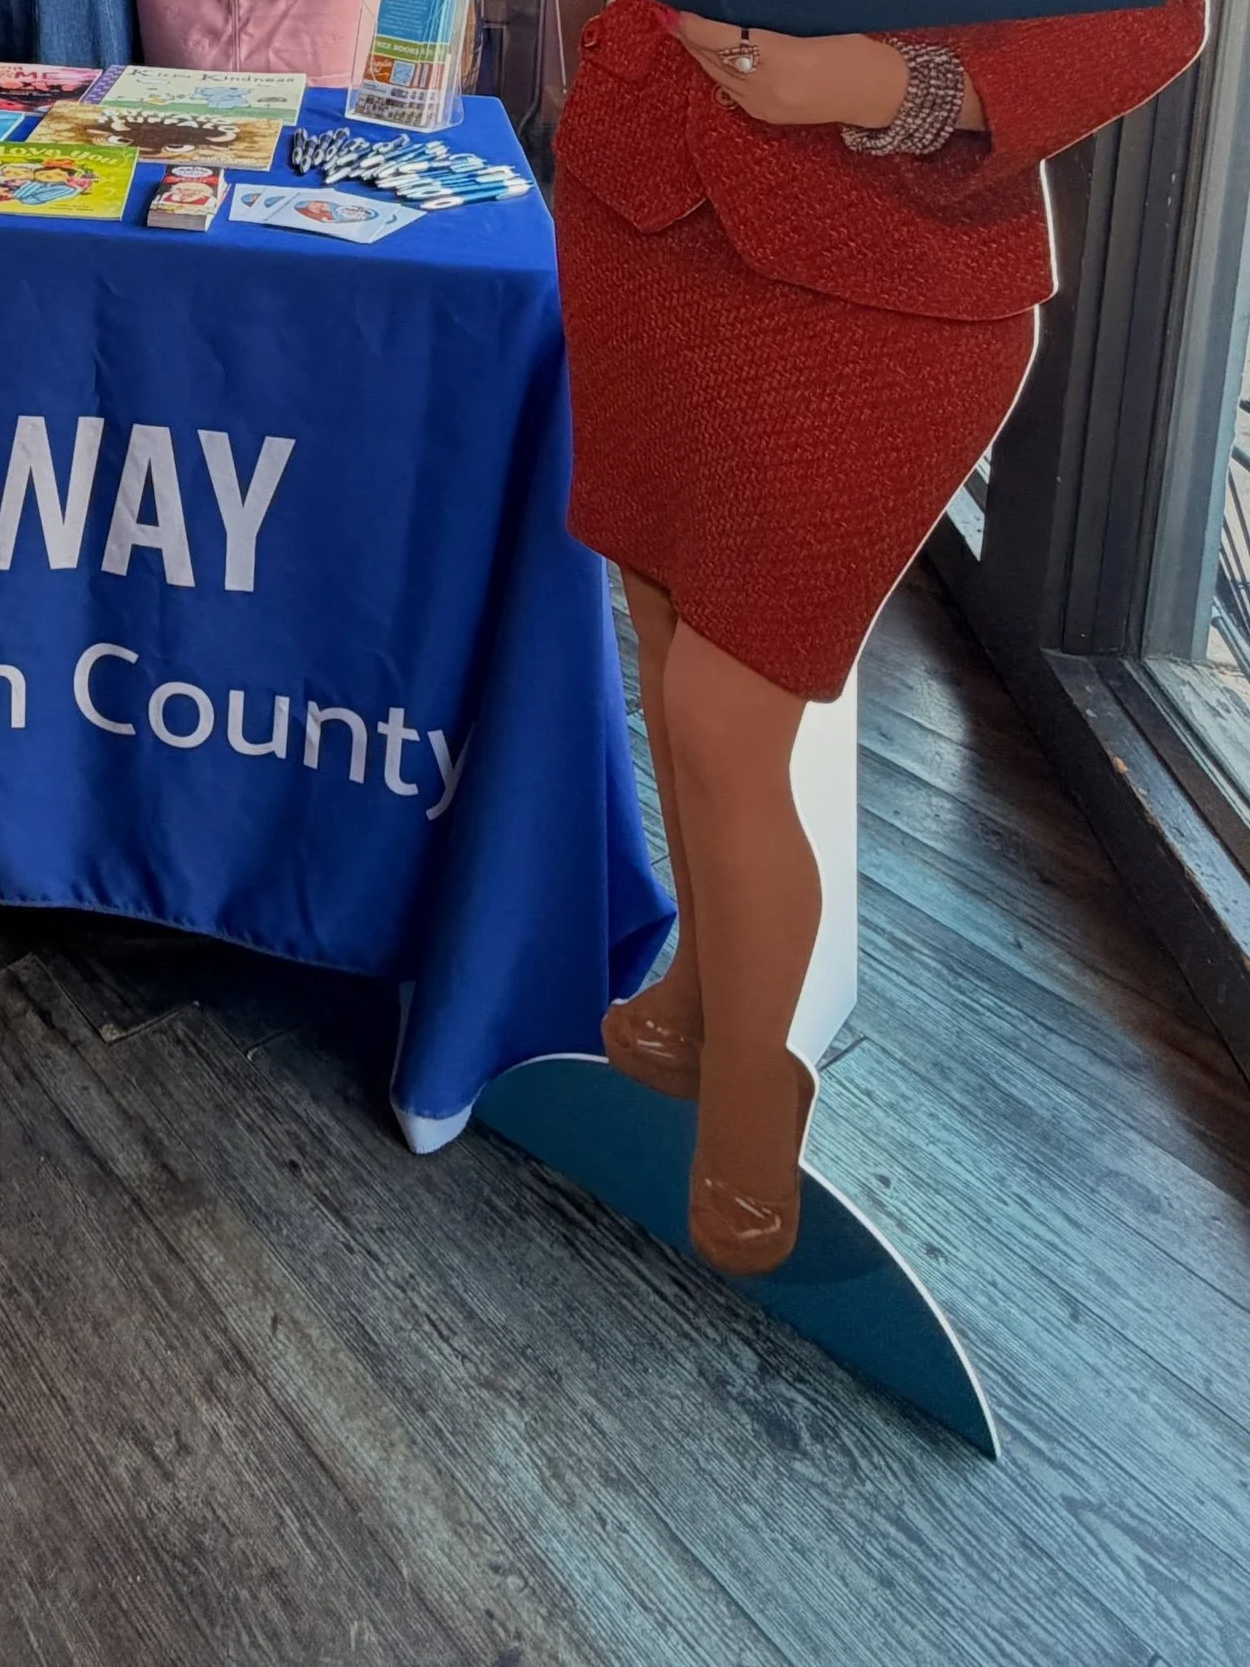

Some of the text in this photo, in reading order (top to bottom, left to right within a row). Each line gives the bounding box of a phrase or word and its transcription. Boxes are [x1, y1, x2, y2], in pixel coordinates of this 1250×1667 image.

[130, 68, 150, 77] K
[200, 72, 294, 84] Kindness
[72, 642, 474, 822] County
